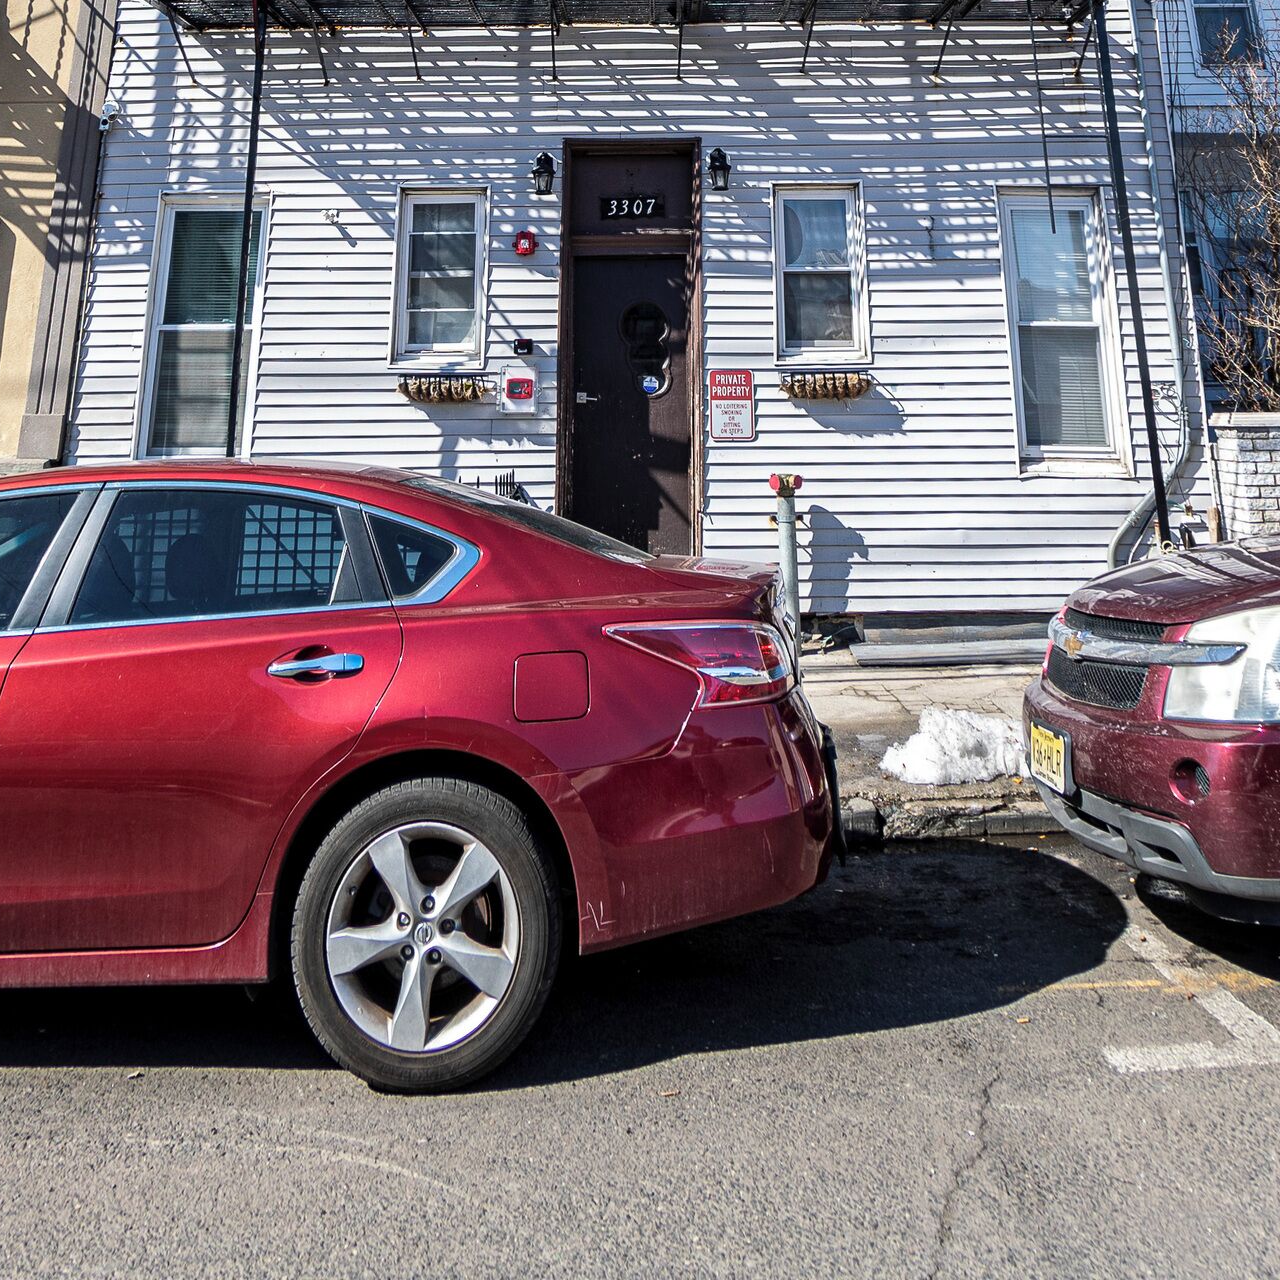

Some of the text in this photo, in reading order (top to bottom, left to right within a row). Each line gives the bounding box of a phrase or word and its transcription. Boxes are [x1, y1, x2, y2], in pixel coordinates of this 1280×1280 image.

[607, 199, 656, 216] 3307
[715, 374, 747, 385] PRIVATE
[712, 386, 750, 397] PROPERTY
